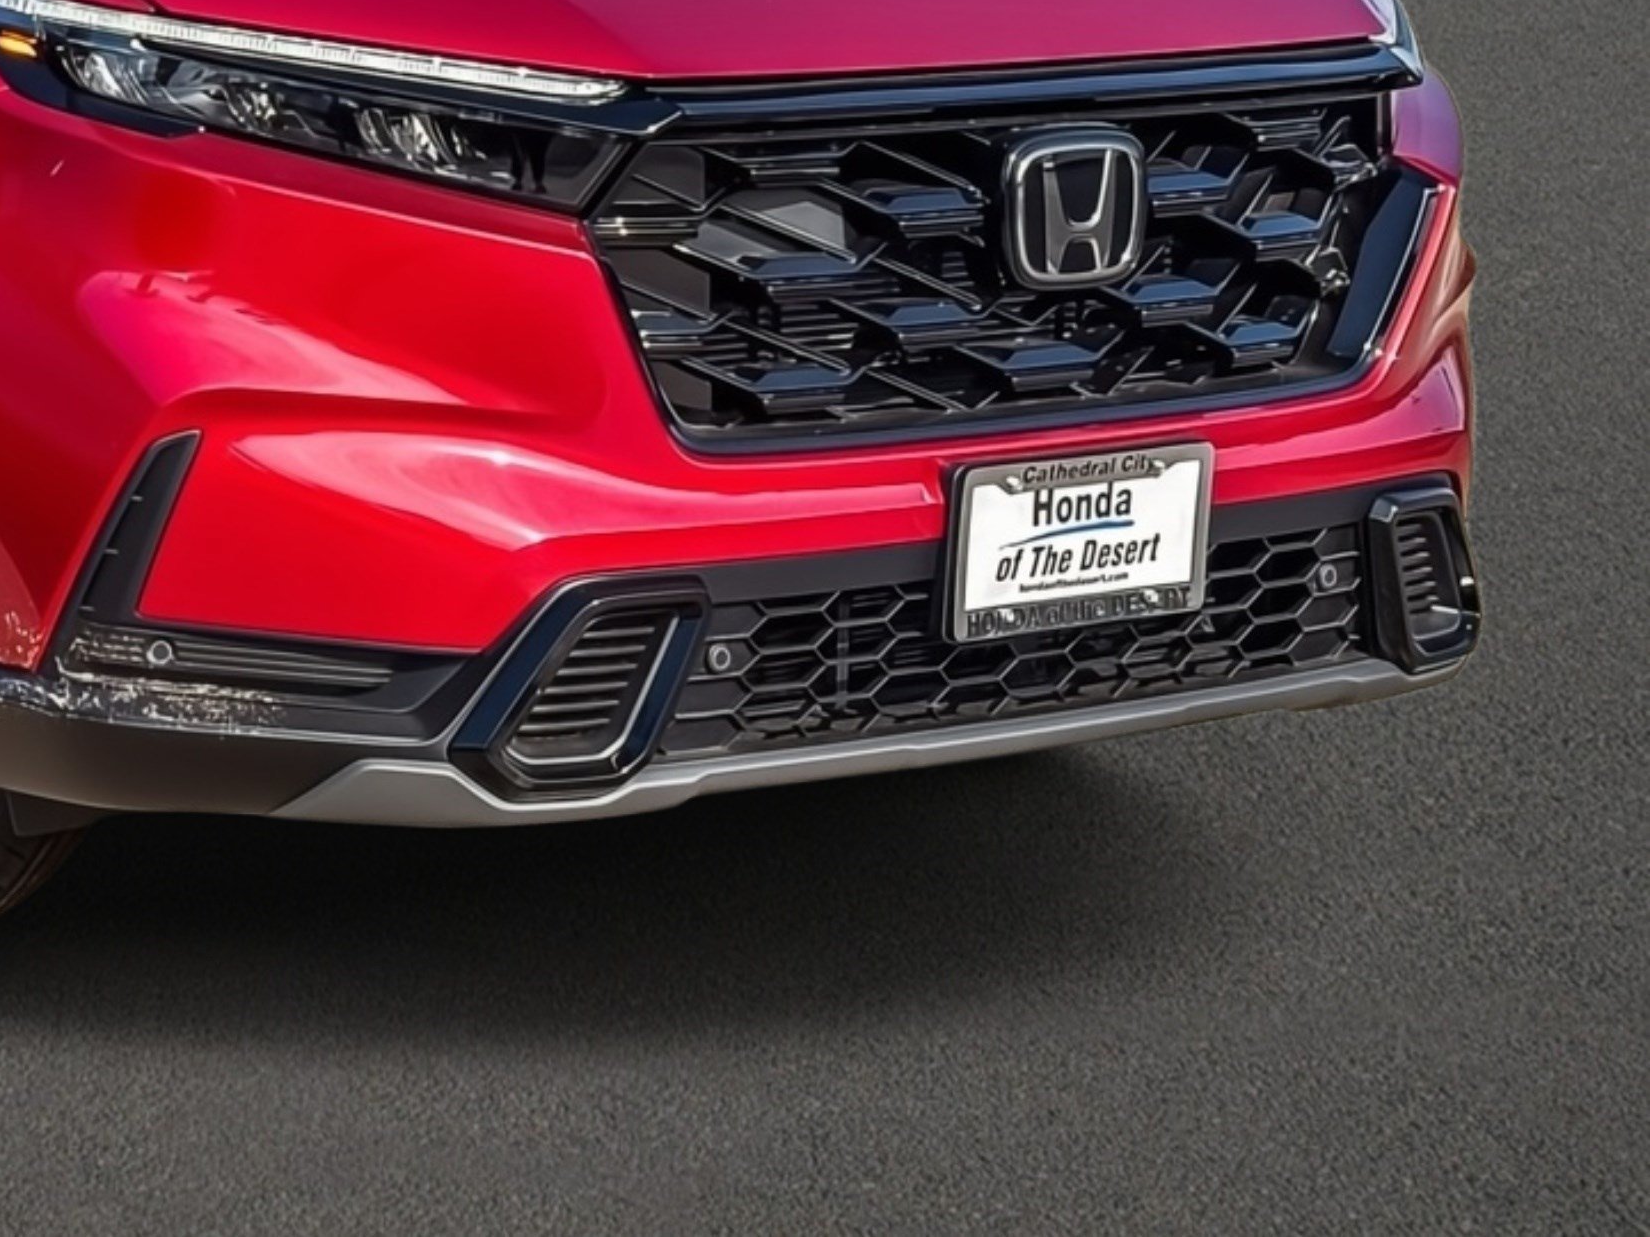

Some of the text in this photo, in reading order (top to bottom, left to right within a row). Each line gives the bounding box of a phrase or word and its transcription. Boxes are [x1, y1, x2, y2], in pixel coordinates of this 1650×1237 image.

[1023, 458, 1116, 483] Cathedral
[1032, 481, 1133, 527] Honda
[995, 533, 1161, 582] of The Desert
